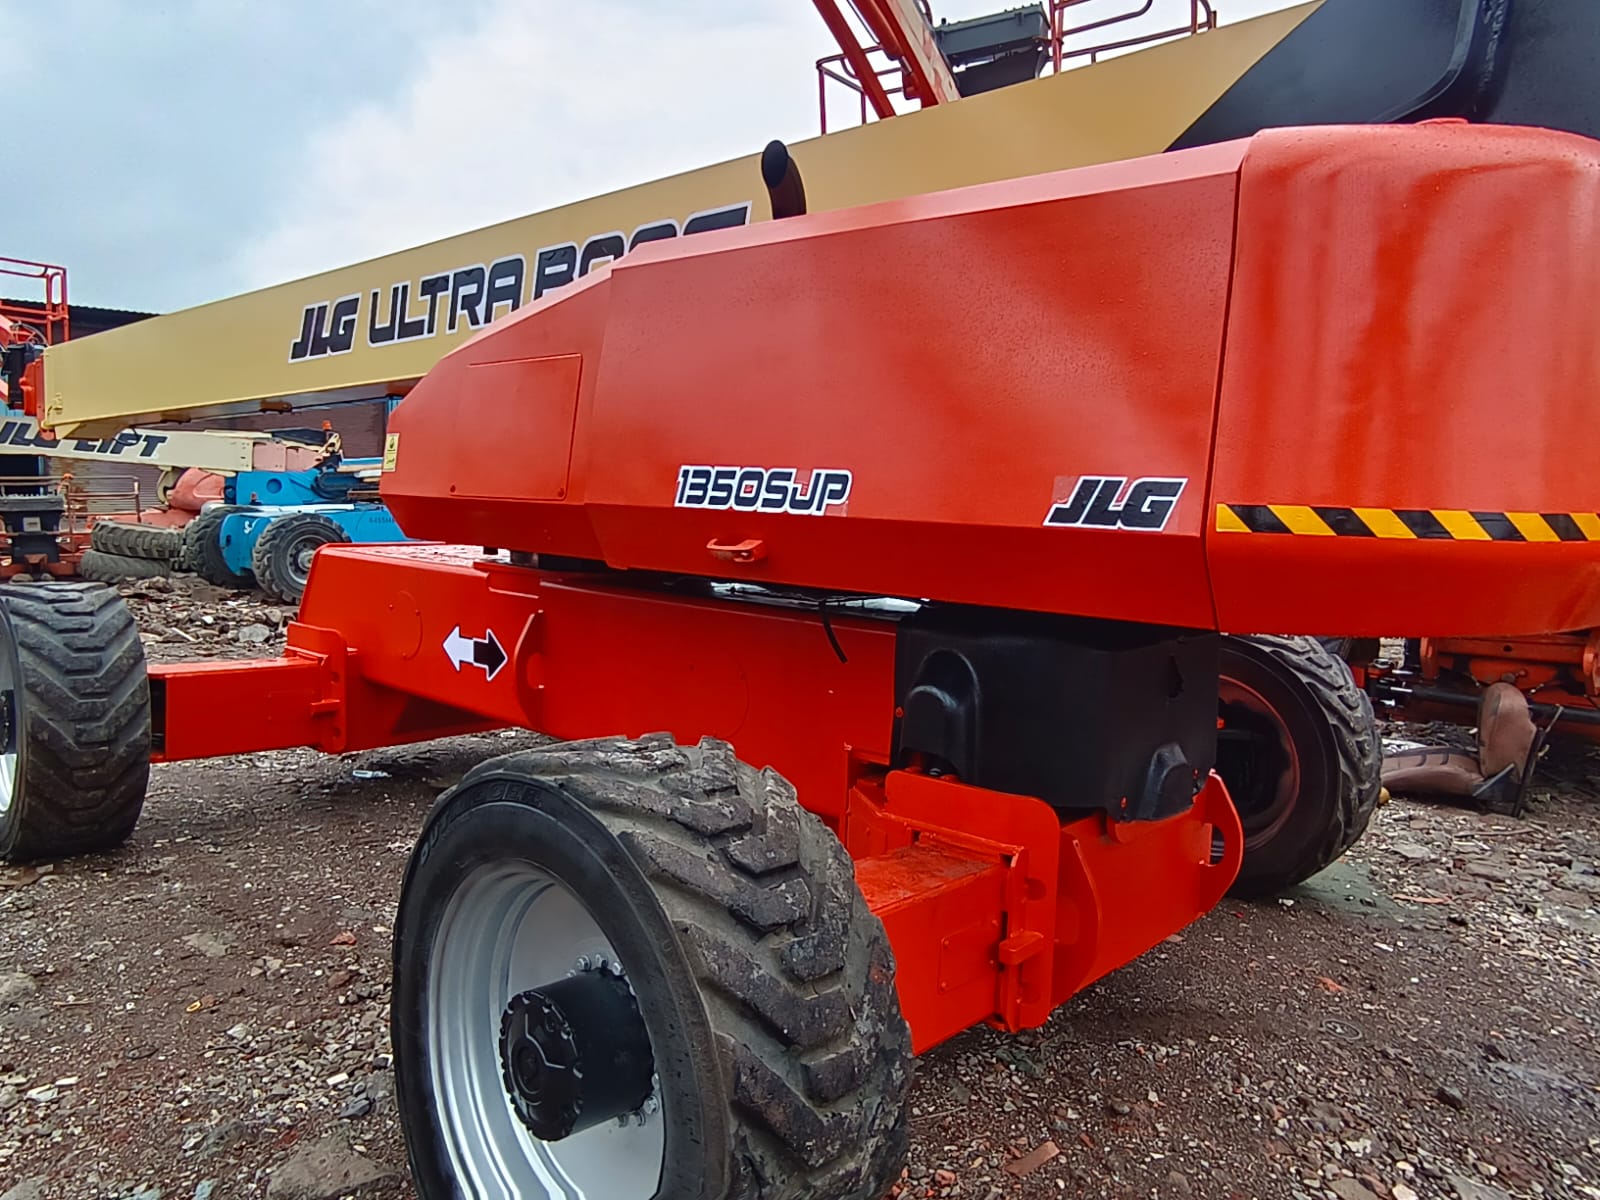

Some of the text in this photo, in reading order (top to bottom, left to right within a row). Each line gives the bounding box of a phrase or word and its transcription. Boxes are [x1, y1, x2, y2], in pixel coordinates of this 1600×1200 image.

[288, 293, 361, 362] JLG
[368, 255, 526, 347] ULTRA
[674, 466, 852, 516] 1350SJP
[1043, 476, 1188, 532] JLG
